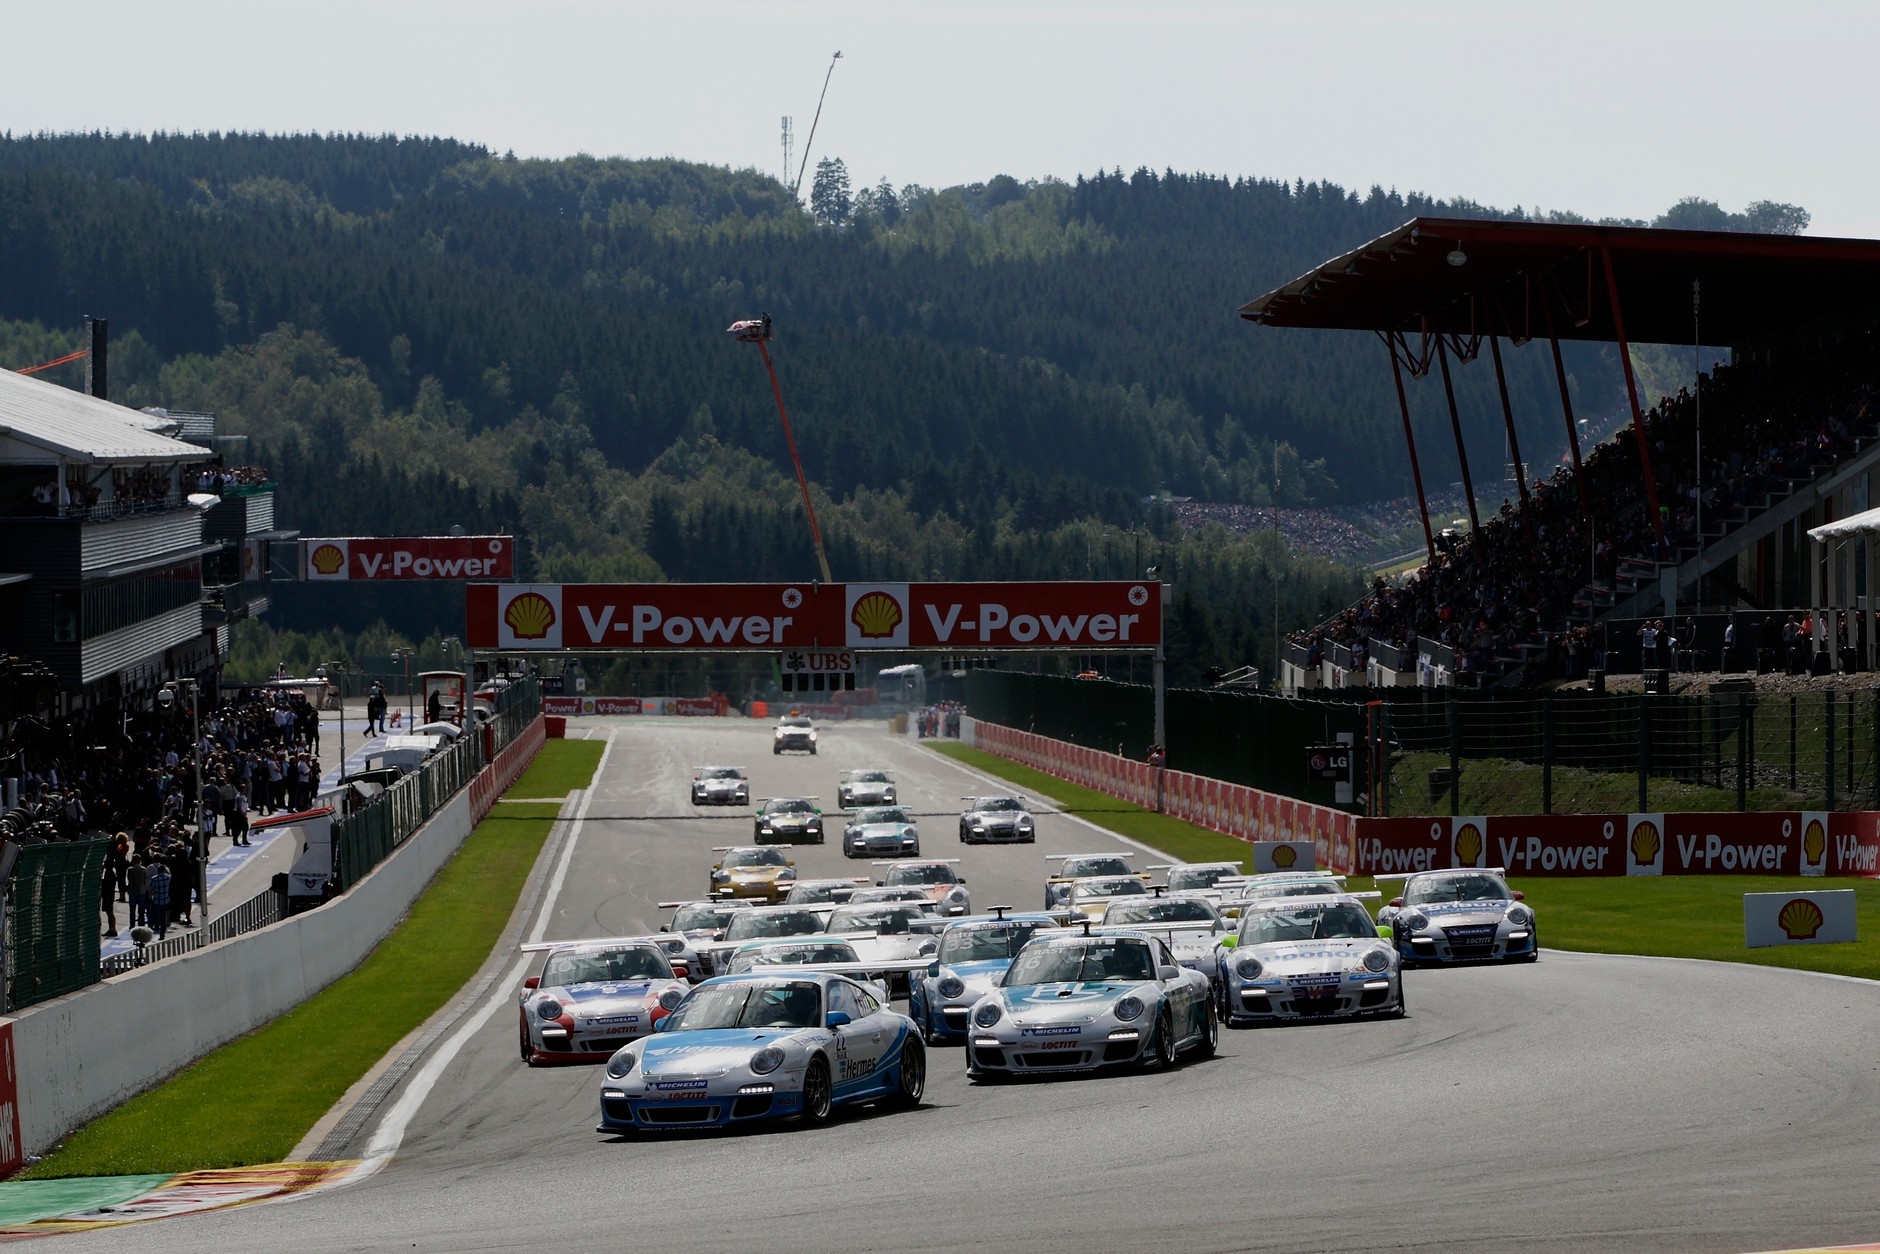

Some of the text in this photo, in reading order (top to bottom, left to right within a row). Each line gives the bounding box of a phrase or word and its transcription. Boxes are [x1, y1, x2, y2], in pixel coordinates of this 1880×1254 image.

[358, 551, 497, 577] V-Power
[577, 605, 793, 643] V-Power
[924, 603, 1139, 642] V-Power
[808, 653, 851, 671] UBS
[1329, 756, 1347, 768] LG
[1358, 837, 1437, 871] V-Power
[1499, 836, 1609, 870] V-Power
[1676, 834, 1787, 869] V-Power
[1836, 835, 1879, 870] V-Power
[1033, 947, 1066, 957] RAST
[1300, 977, 1339, 985] MICHELIN
[599, 1016, 637, 1024] MICHELIN
[606, 1026, 637, 1034] LOCTITE
[832, 1033, 847, 1052] 22
[1041, 1041, 1078, 1049] LOCTITE
[846, 1057, 877, 1079] Hermes
[668, 1092, 707, 1100] LOCTITE
